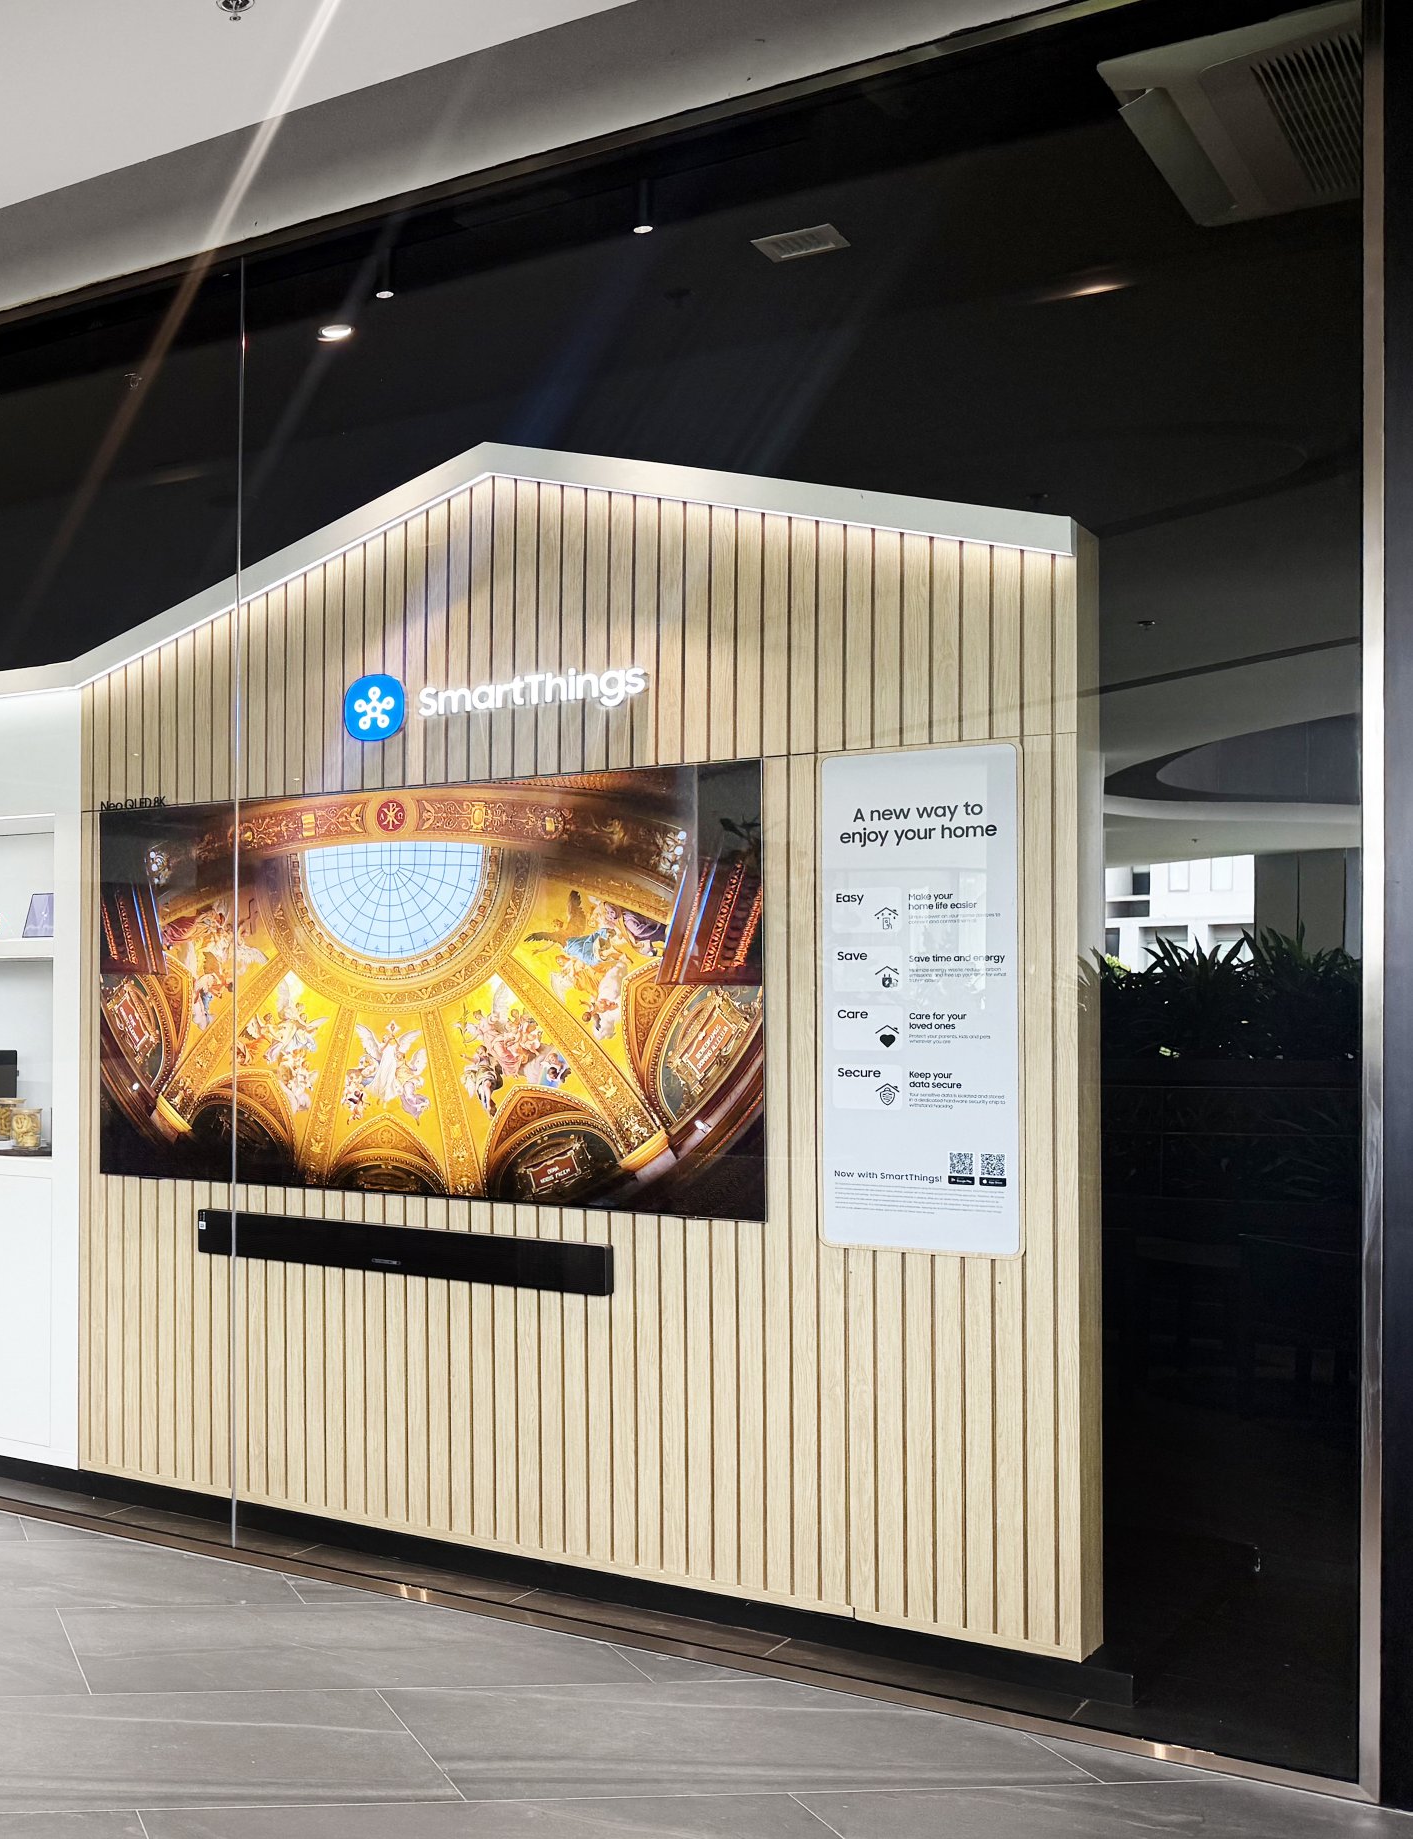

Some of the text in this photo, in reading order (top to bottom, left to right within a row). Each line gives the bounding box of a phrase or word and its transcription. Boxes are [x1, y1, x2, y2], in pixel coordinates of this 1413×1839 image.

[418, 667, 646, 717] SmartThings
[100, 801, 123, 811] Neo
[125, 797, 152, 809] QLED
[853, 801, 983, 822] A new way to
[839, 824, 997, 848] enjoy your home
[835, 893, 864, 905] Easy
[908, 893, 953, 902] Make your
[908, 902, 934, 910] home
[950, 901, 977, 909] easier
[837, 951, 868, 961] Save
[932, 954, 952, 962] time
[953, 954, 971, 962] and
[973, 954, 1005, 963] energy
[837, 1009, 869, 1019] Care
[909, 1012, 967, 1022] Care for your
[909, 1022, 956, 1030] loved ones
[837, 1067, 881, 1078] Secure
[909, 1071, 953, 1080] Keep your
[909, 1080, 930, 1088] data
[834, 1170, 942, 1184] Now with SmartThings!
